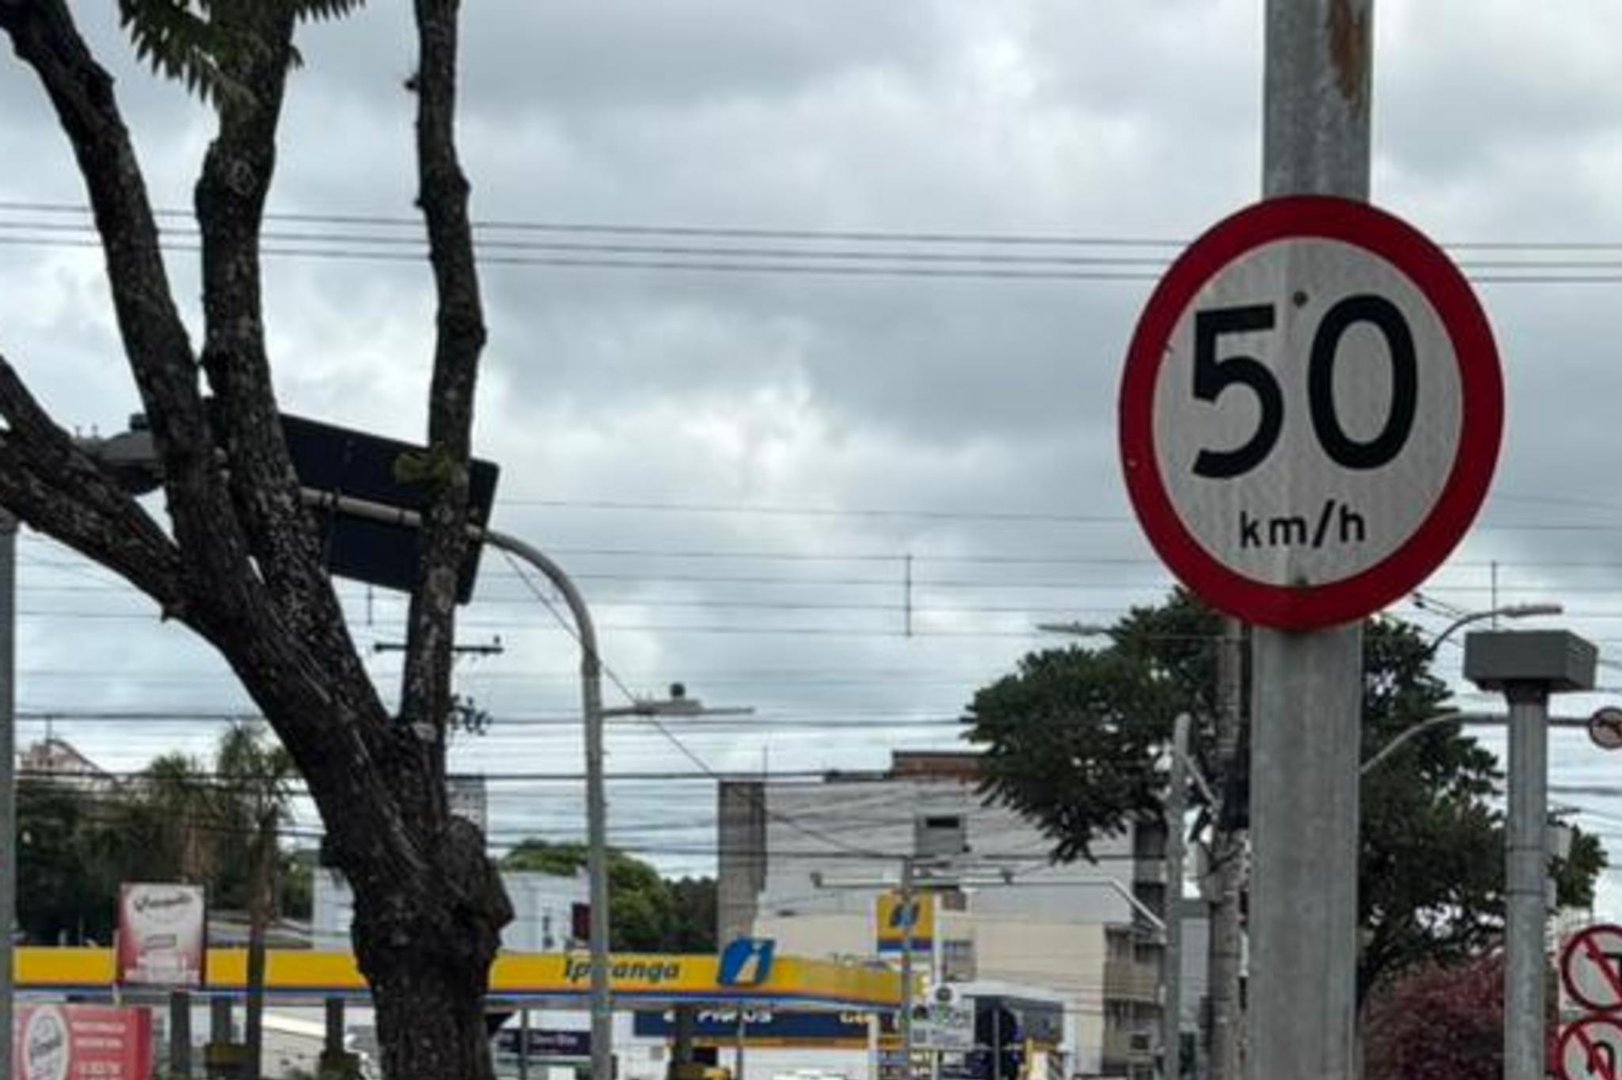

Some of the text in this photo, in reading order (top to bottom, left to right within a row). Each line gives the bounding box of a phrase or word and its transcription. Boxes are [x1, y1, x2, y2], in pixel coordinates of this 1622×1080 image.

[1192, 294, 1418, 479] 50
[1240, 499, 1366, 549] km/h
[564, 957, 681, 984] Ipanga
